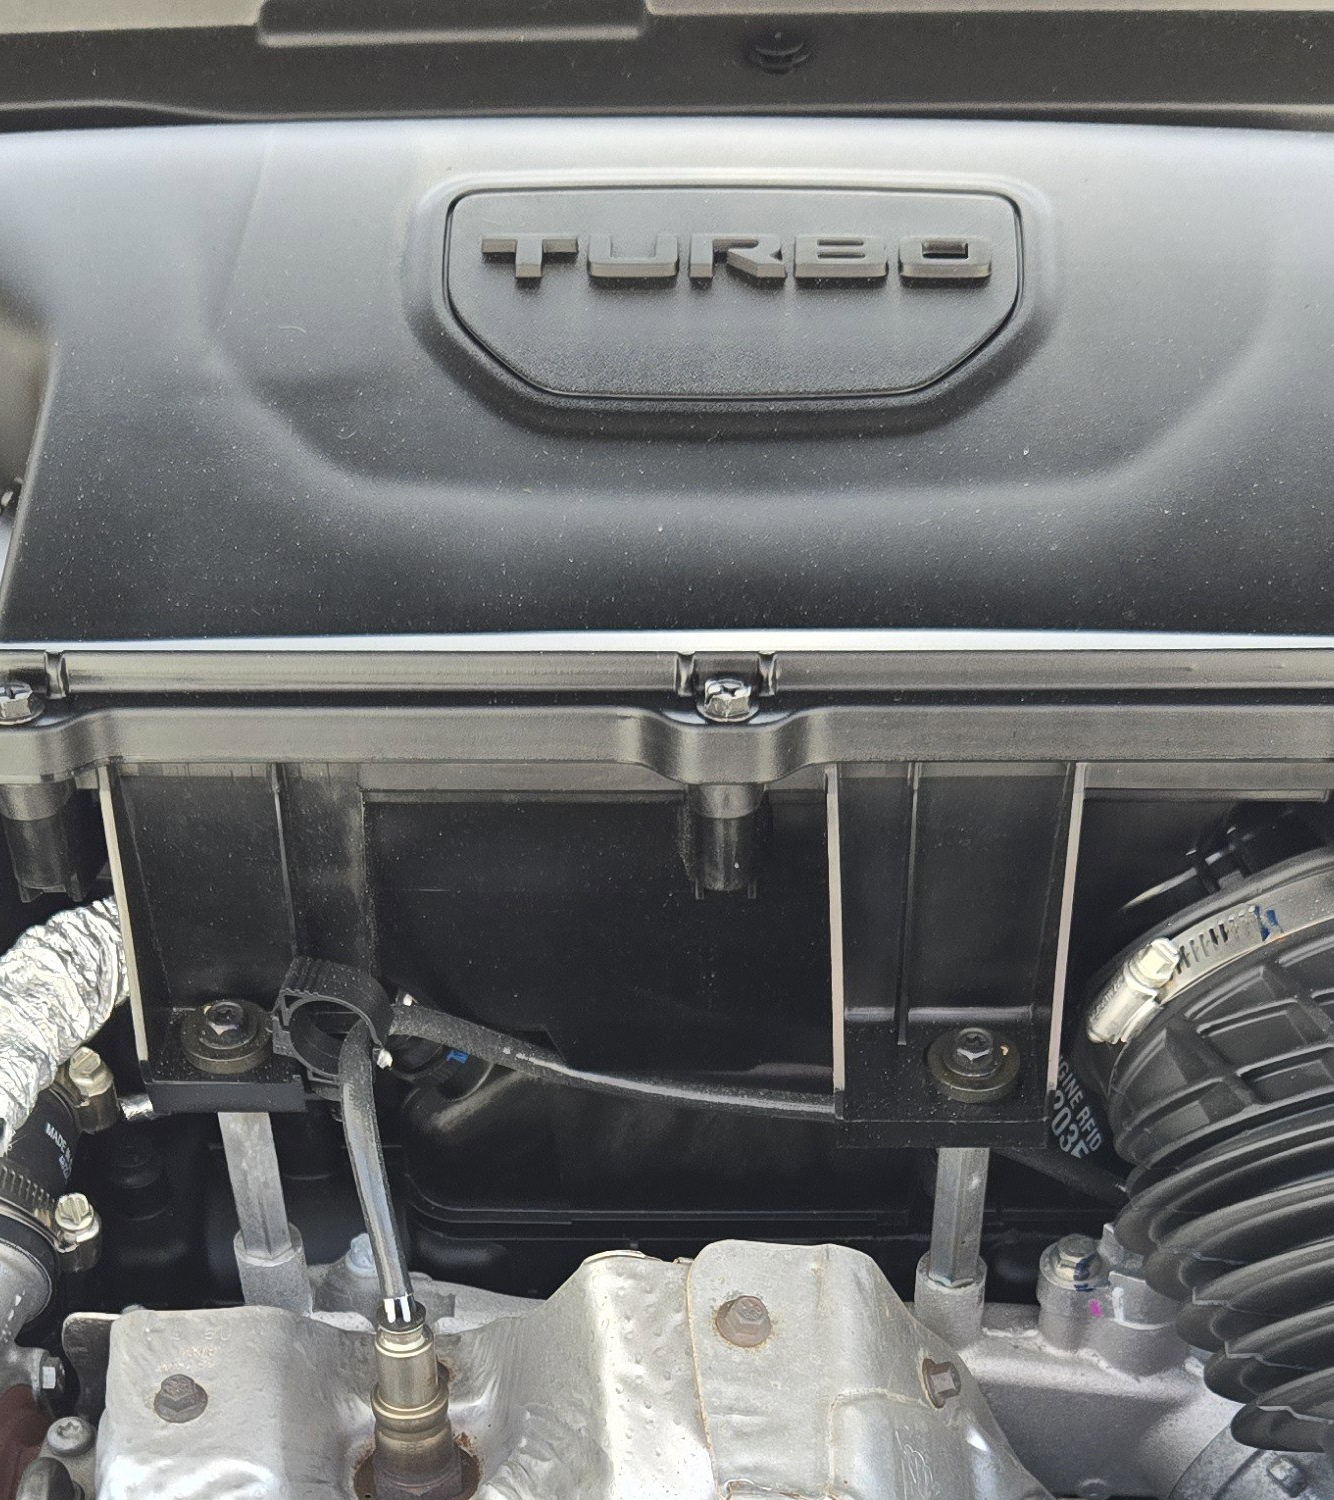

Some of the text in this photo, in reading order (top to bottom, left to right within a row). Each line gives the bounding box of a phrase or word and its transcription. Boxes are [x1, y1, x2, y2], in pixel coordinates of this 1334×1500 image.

[480, 233, 992, 280] TURBO
[1058, 1055, 1102, 1152] GINE RFID
[45, 1121, 67, 1154] MADE
